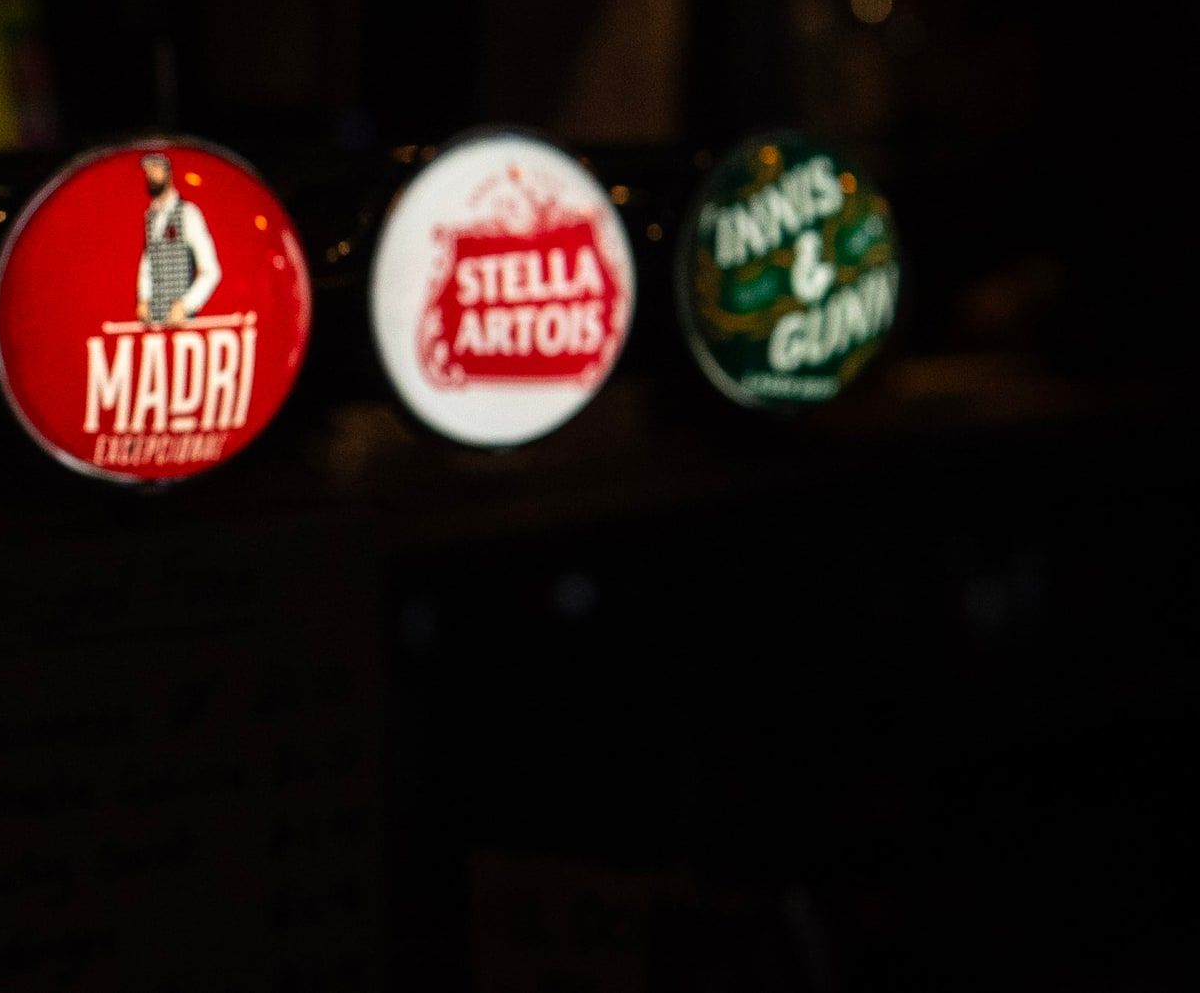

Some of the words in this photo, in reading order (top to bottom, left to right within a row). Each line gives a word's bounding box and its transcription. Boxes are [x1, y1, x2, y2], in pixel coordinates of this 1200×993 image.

[699, 155, 844, 271] INNIS
[456, 247, 600, 305] STELLA
[790, 229, 836, 304] &
[454, 300, 604, 356] ARTOIS
[768, 263, 900, 373] GUNN
